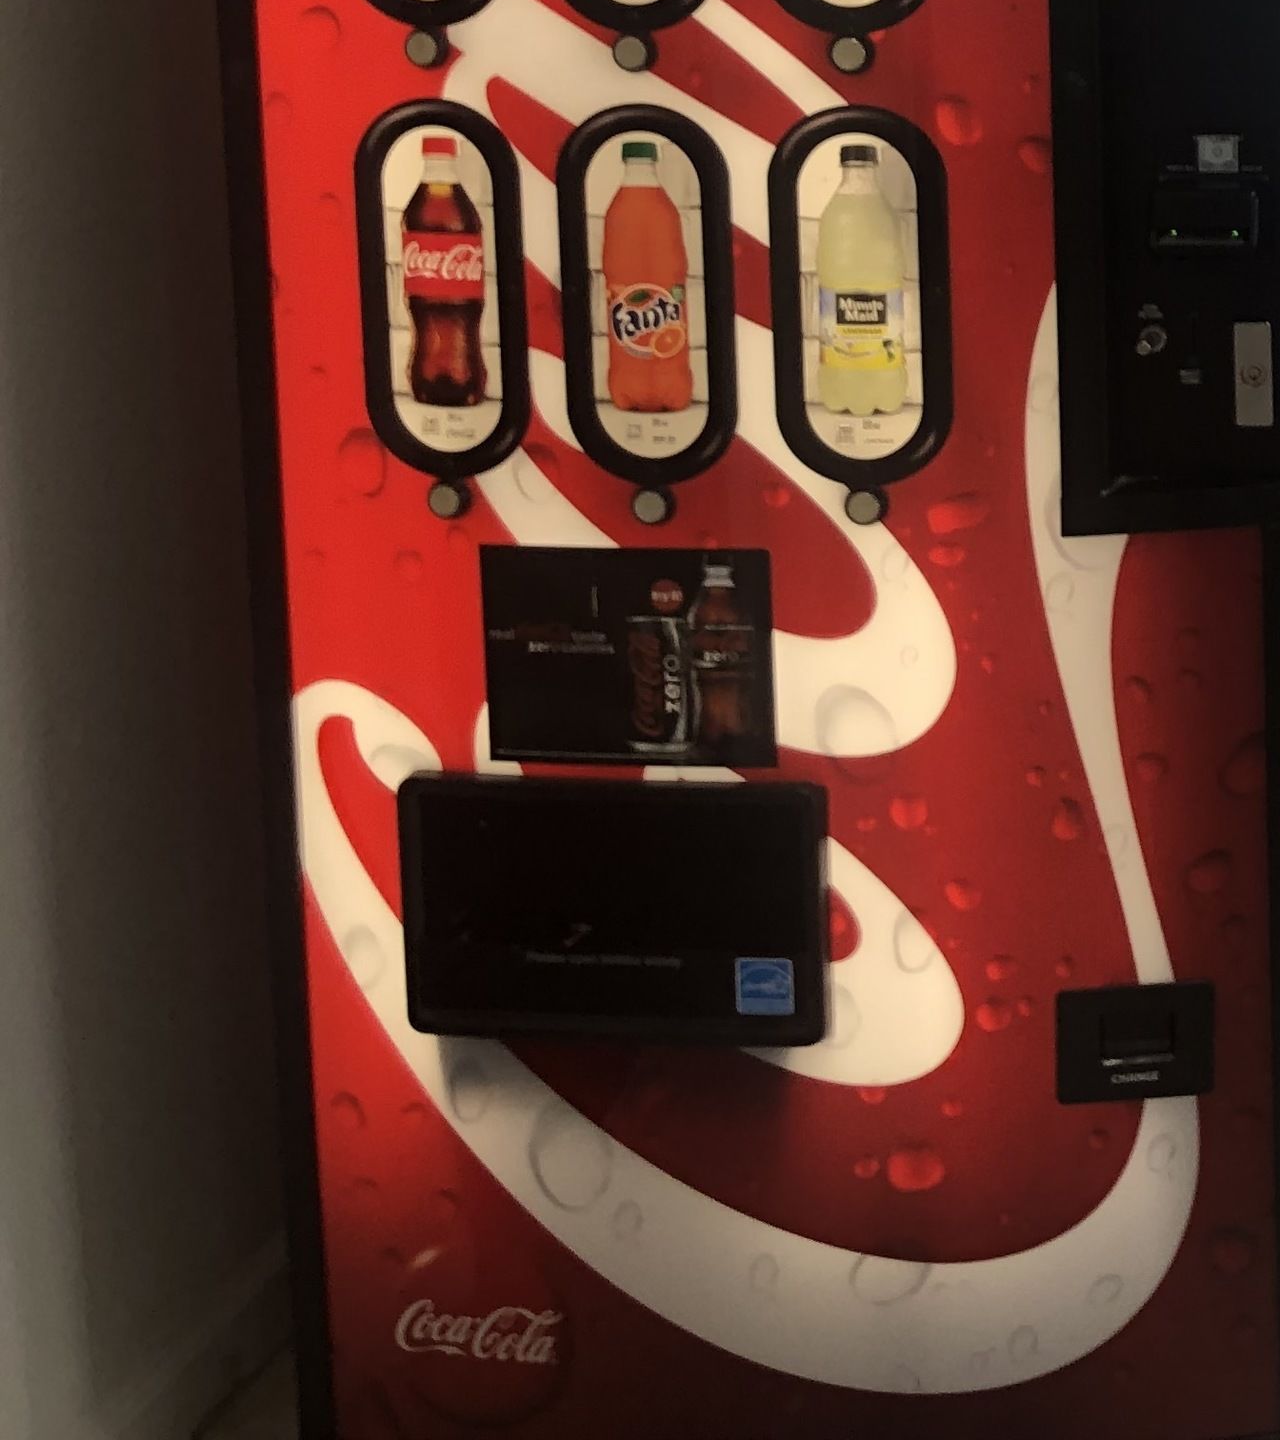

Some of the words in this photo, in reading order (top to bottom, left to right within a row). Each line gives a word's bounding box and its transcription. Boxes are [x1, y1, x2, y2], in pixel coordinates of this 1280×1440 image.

[612, 296, 681, 342] Fanta
[839, 296, 884, 311] Minute
[845, 309, 878, 322] Maid
[663, 654, 681, 714] zero
[394, 1298, 563, 1366] Coca-Cola
